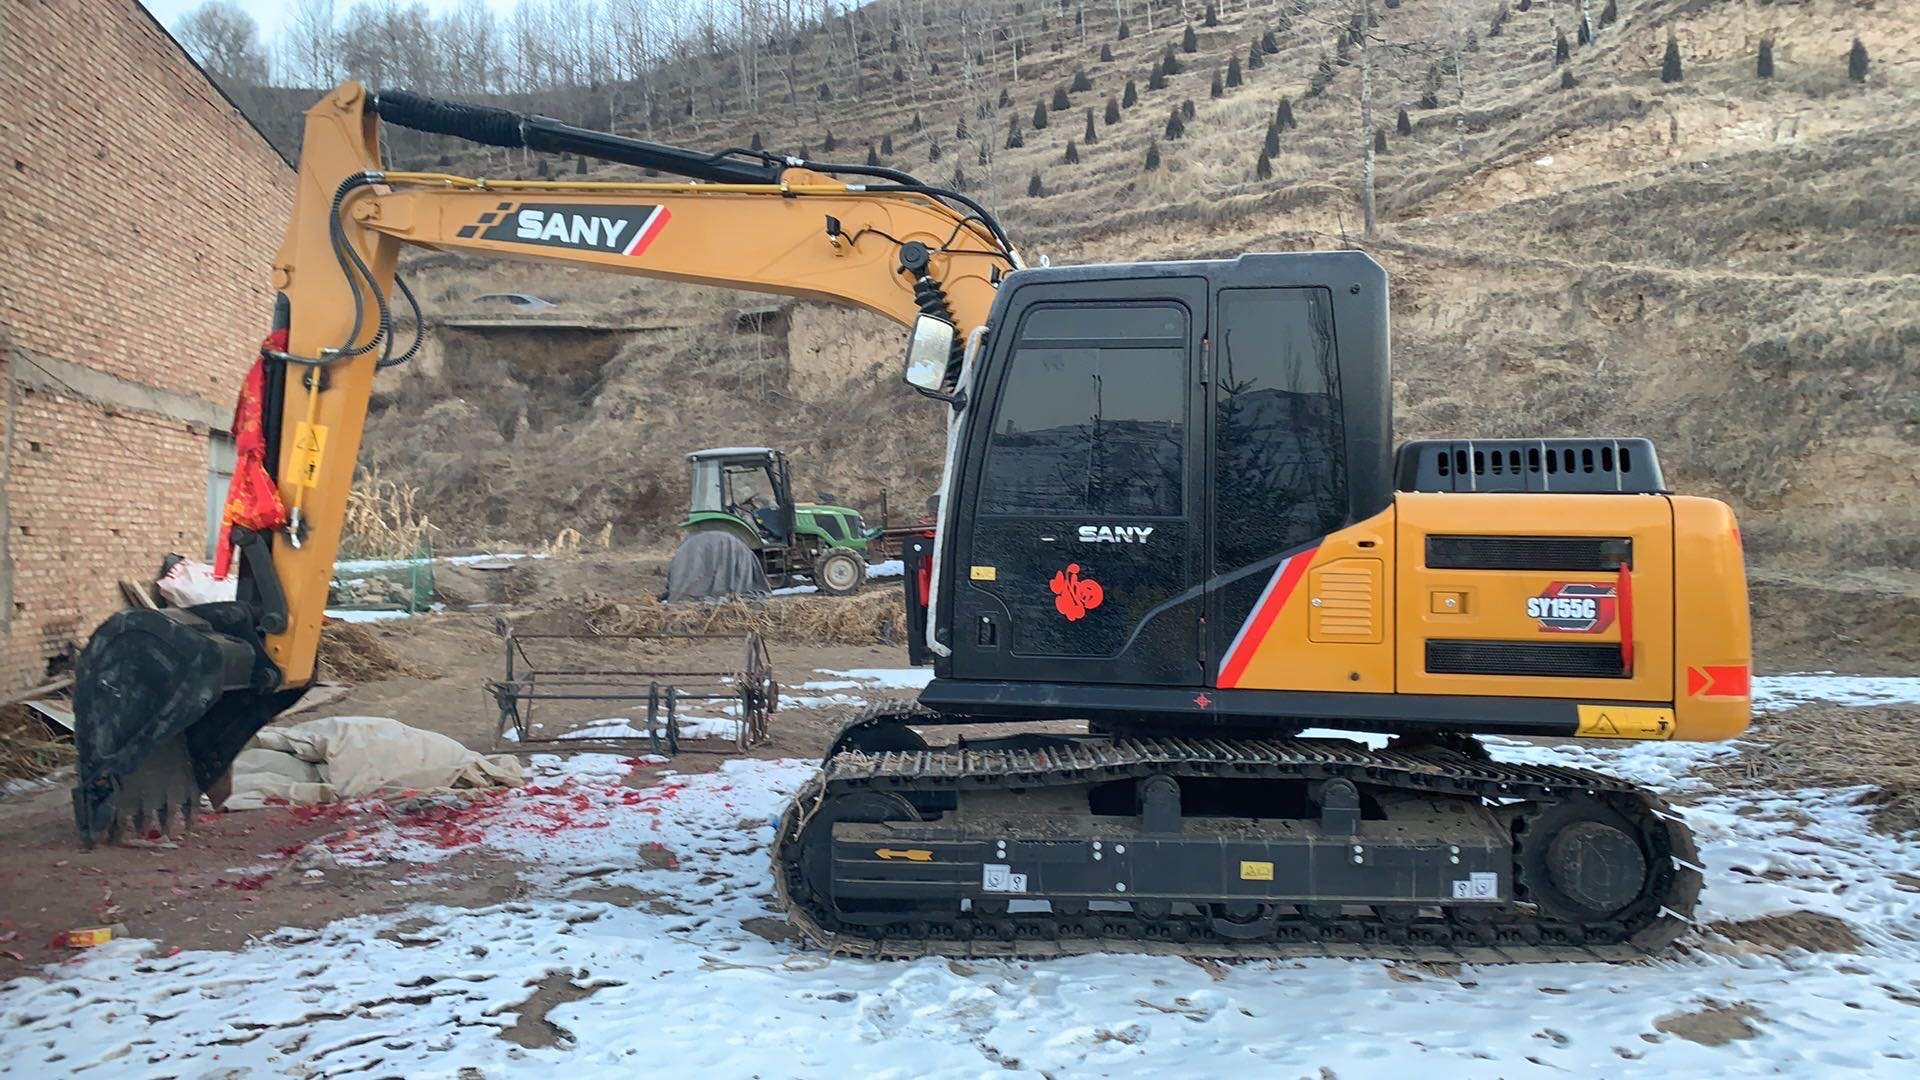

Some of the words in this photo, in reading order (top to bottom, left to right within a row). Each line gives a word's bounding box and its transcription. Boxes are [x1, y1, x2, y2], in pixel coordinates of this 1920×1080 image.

[516, 209, 628, 247] SANY
[1078, 526, 1154, 544] SANY
[1527, 597, 1596, 619] SY155C
